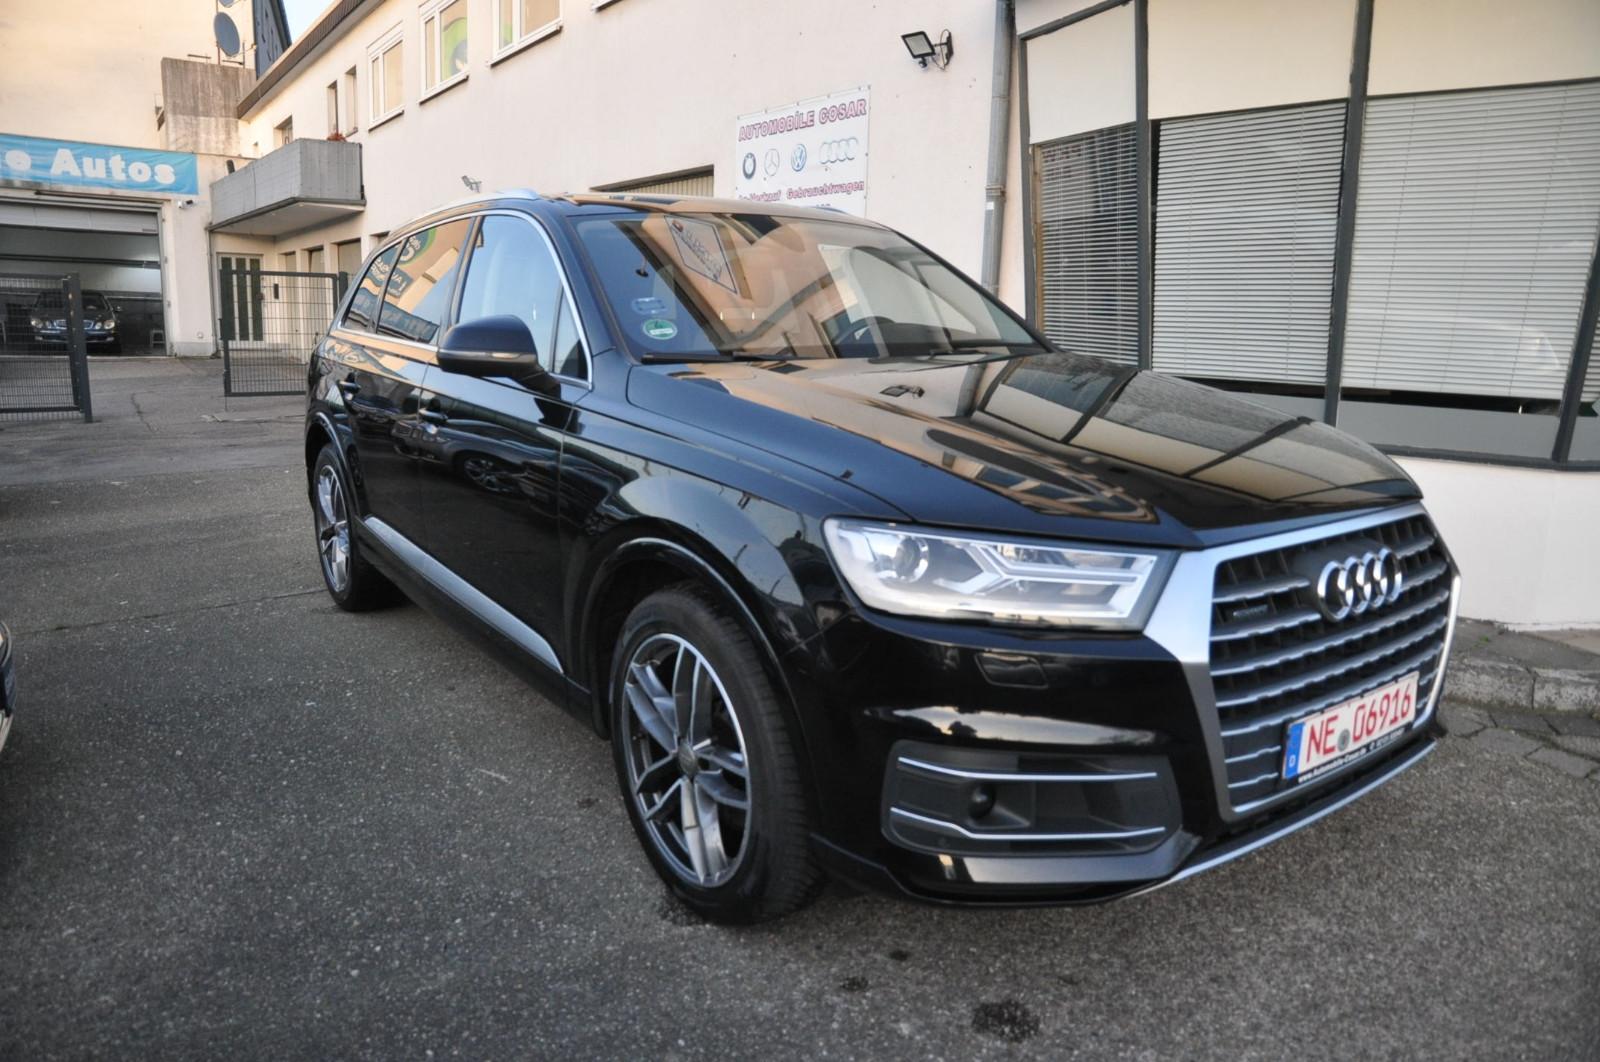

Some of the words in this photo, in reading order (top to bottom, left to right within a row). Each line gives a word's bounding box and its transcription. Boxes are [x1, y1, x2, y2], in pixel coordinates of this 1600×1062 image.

[50, 148, 176, 185] Autos
[786, 181, 865, 200] Gebrauchtwagen
[1306, 714, 1339, 763] NE
[1353, 683, 1411, 743] 06916
